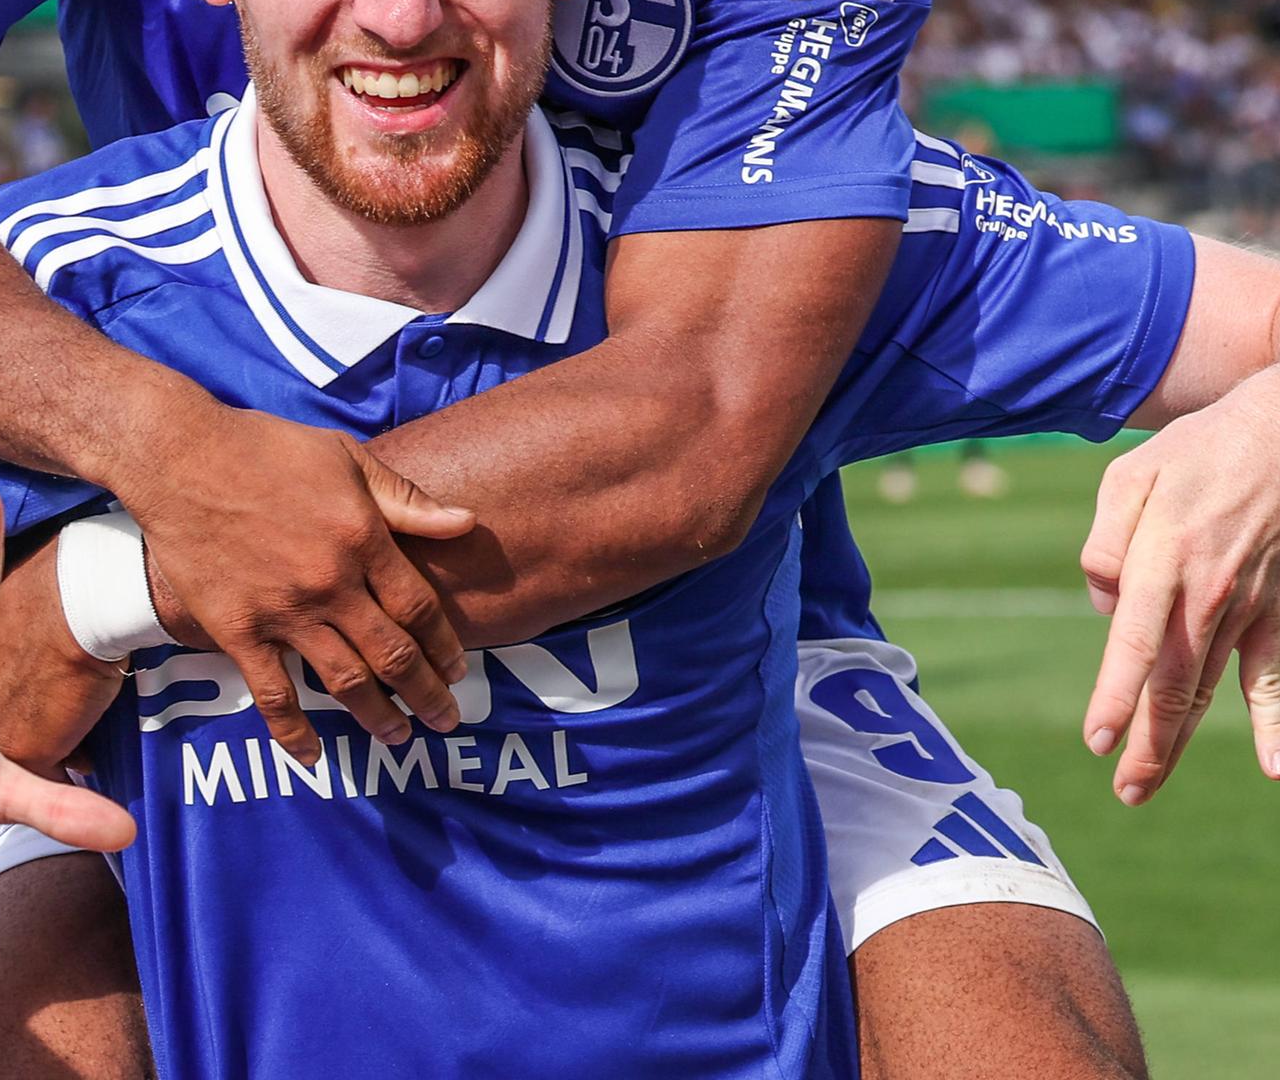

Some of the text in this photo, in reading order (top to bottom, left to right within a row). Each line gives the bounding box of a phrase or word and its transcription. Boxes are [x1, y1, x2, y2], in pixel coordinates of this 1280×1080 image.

[583, 25, 623, 74] 04
[771, 18, 807, 75] Gruppe
[742, 19, 838, 184] HEGMANNS
[975, 215, 1028, 241] Gruppe
[809, 668, 977, 785] 9
[181, 729, 589, 807] MINIMEAL
